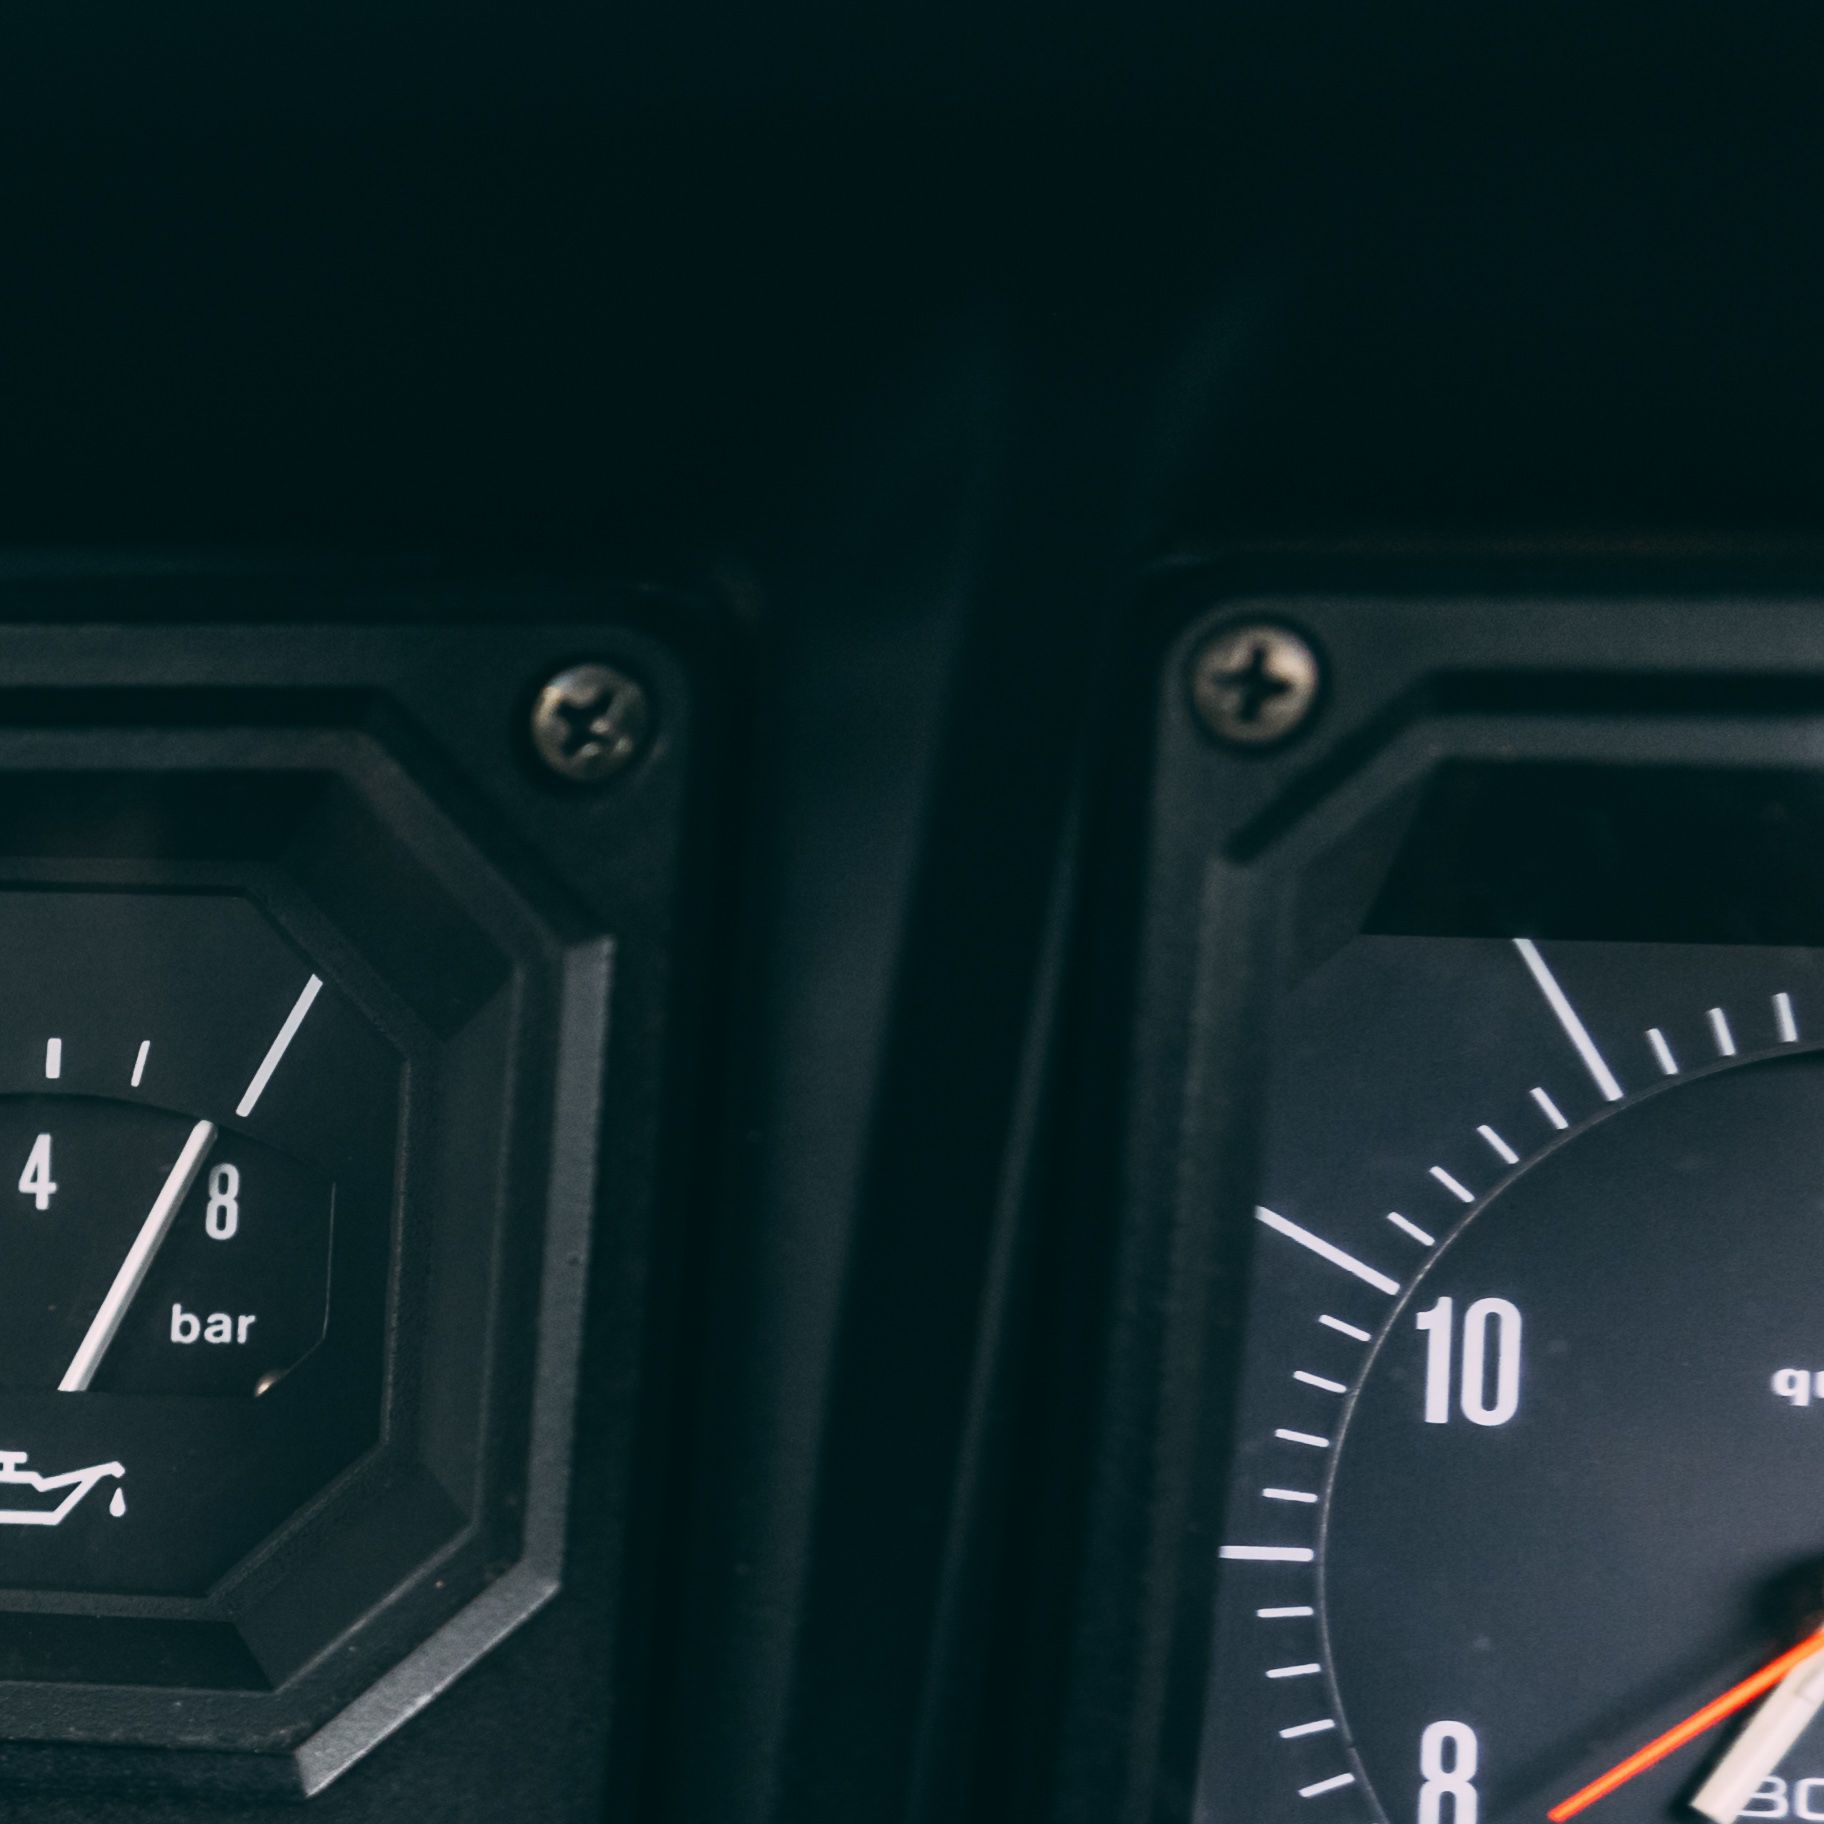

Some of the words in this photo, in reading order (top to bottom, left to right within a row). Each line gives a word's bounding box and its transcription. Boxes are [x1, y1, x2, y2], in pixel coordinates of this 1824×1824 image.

[18, 1133, 57, 1210] 4
[205, 1164, 240, 1240] 8
[170, 1303, 257, 1344] bar
[1416, 1296, 1523, 1427] 10
[1772, 1369, 1824, 1406] q
